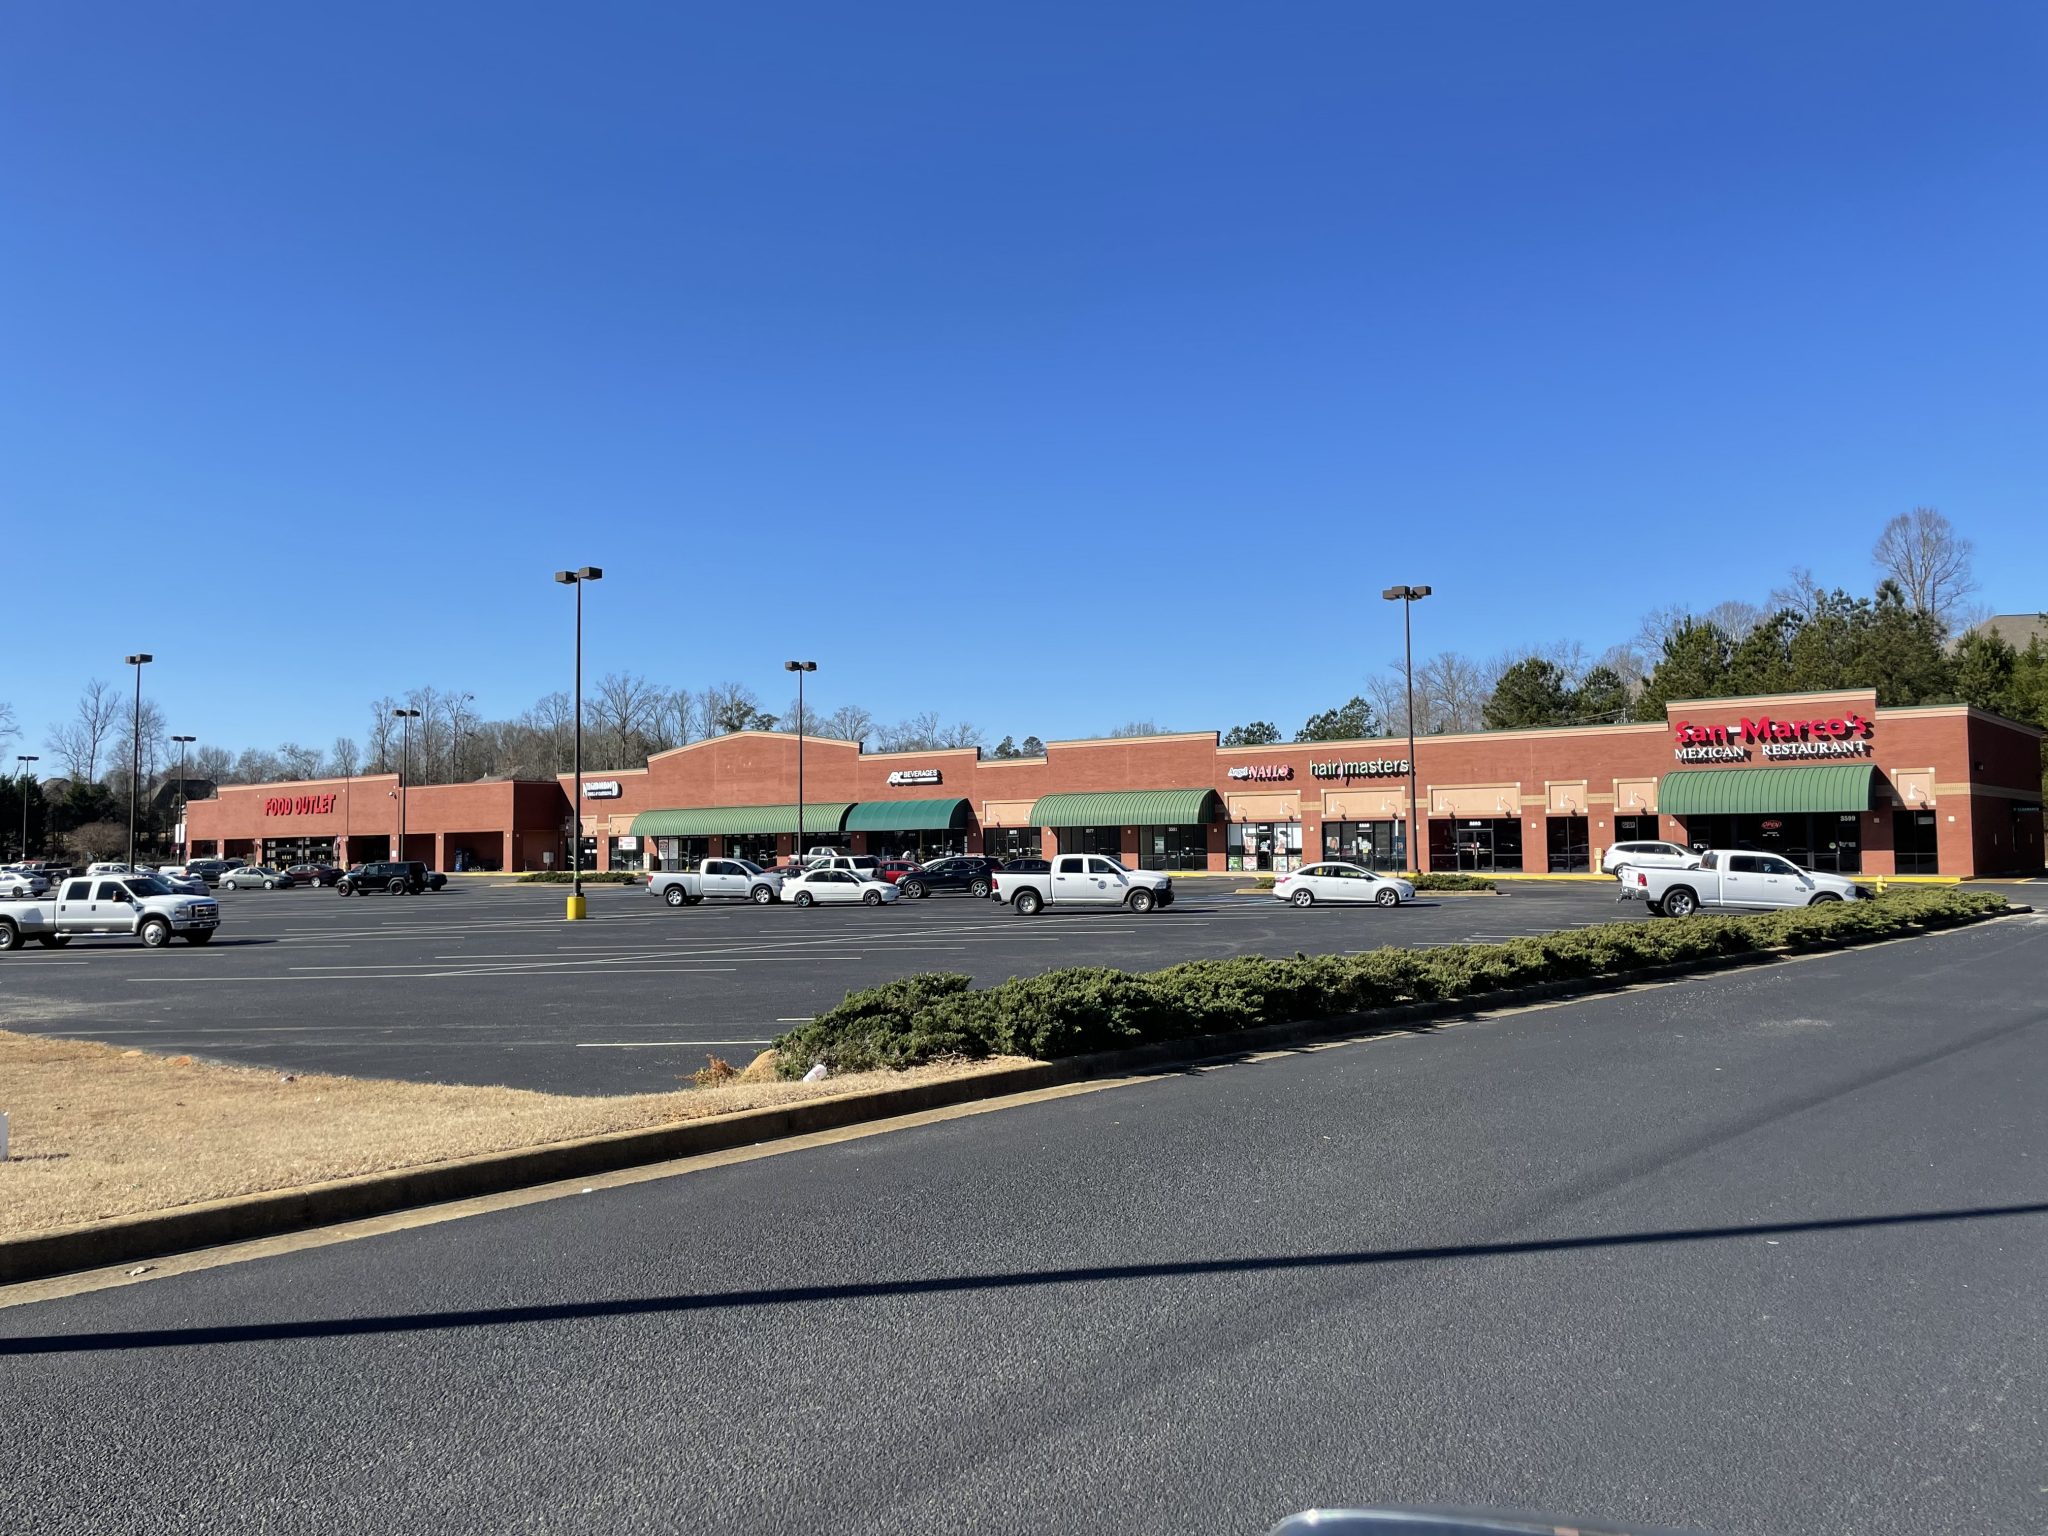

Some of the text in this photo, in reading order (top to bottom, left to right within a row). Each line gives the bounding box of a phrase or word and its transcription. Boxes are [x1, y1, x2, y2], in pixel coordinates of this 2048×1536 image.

[1675, 711, 1866, 742] San Marco's
[1675, 741, 1866, 759] MEXICAN RESTAURANT
[903, 769, 937, 778] BEVERAGES
[1249, 764, 1289, 778] NAILS
[265, 794, 336, 816] FOOD OUTLET
